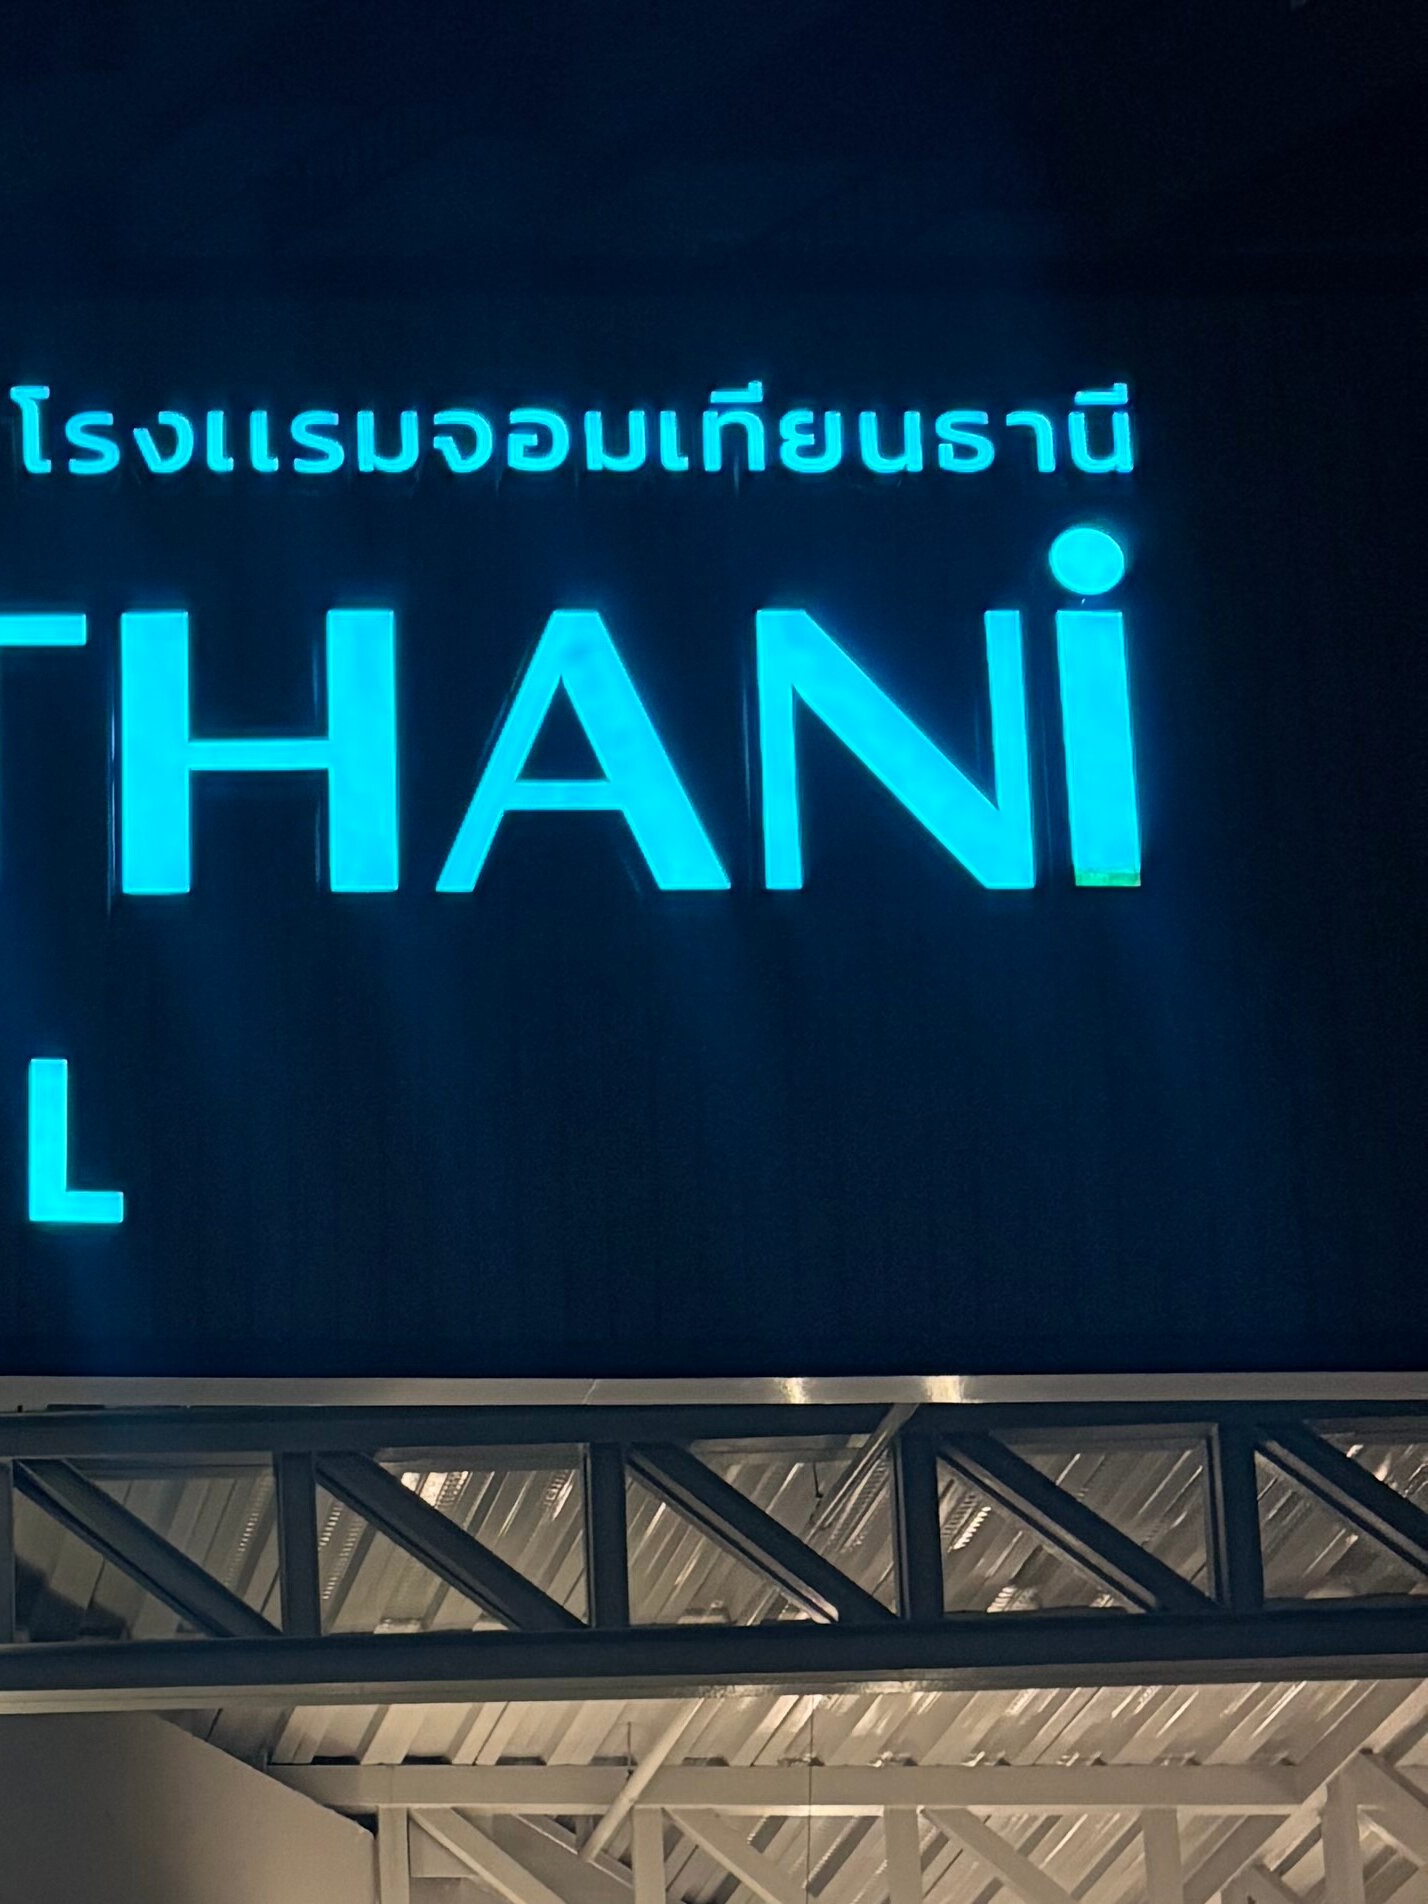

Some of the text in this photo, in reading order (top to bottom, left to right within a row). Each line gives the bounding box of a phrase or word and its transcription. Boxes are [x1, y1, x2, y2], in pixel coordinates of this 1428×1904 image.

[8, 380, 1134, 475] โรงแรมจอมเทียนธานี
